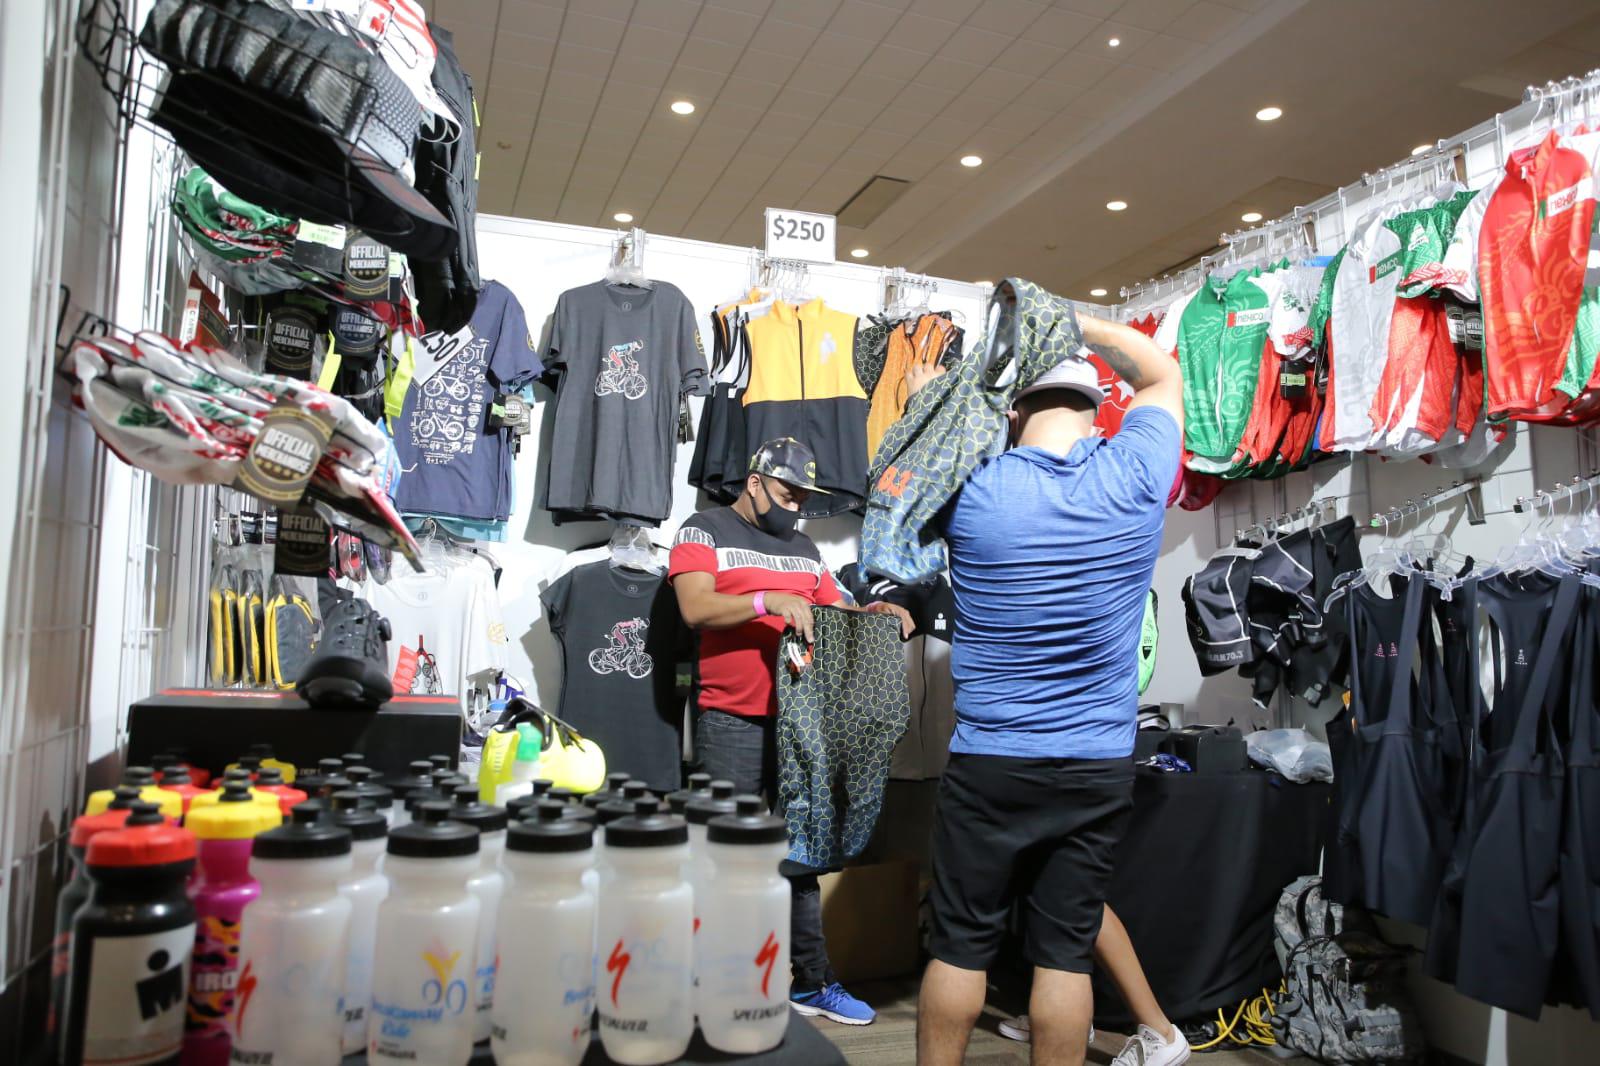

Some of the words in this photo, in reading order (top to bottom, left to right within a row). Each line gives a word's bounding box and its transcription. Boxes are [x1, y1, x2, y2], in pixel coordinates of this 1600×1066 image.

[773, 215, 825, 242] $250
[350, 244, 386, 258] OFFICIAL
[349, 259, 387, 269] MERCHANDISE
[275, 322, 309, 340] OFFICIAL
[340, 323, 375, 334] MERCHANDISE
[272, 335, 310, 349] MERCHANDISE
[264, 428, 315, 460] OFFICIAL
[255, 444, 312, 474] MERCHANDISE
[281, 514, 325, 531] OFFICIAL
